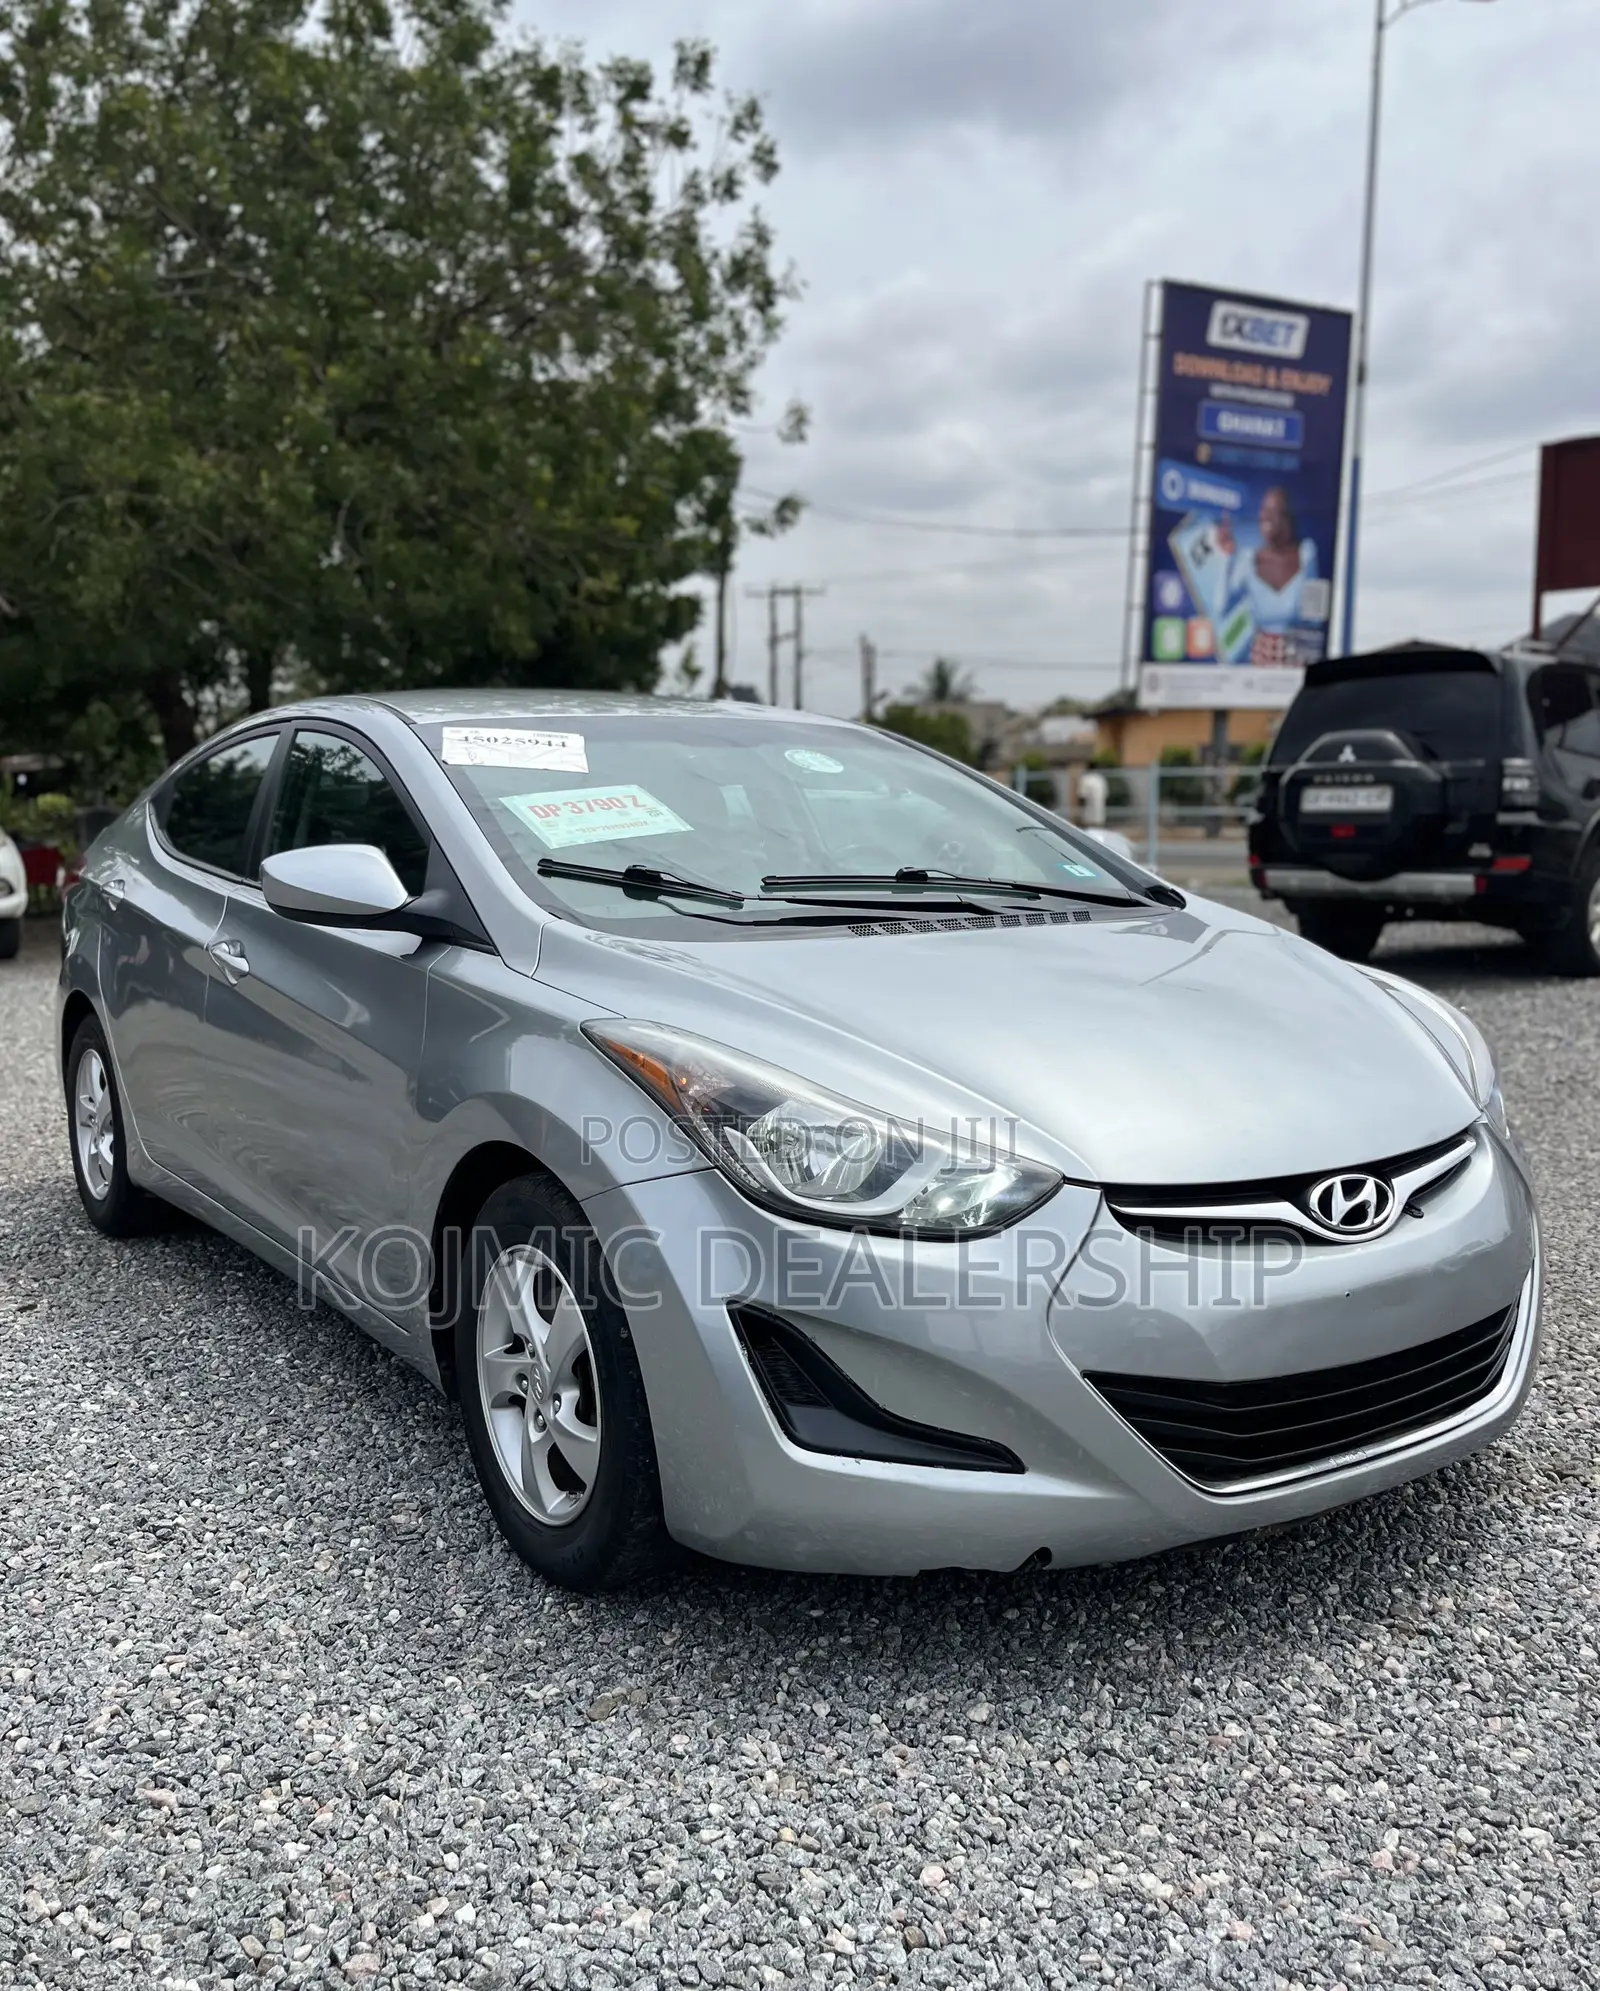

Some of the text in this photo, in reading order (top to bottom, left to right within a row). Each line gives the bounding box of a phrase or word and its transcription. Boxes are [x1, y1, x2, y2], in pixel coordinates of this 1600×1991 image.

[458, 735, 567, 748] 45025944
[527, 804, 561, 819] DP
[563, 796, 628, 815] 3790
